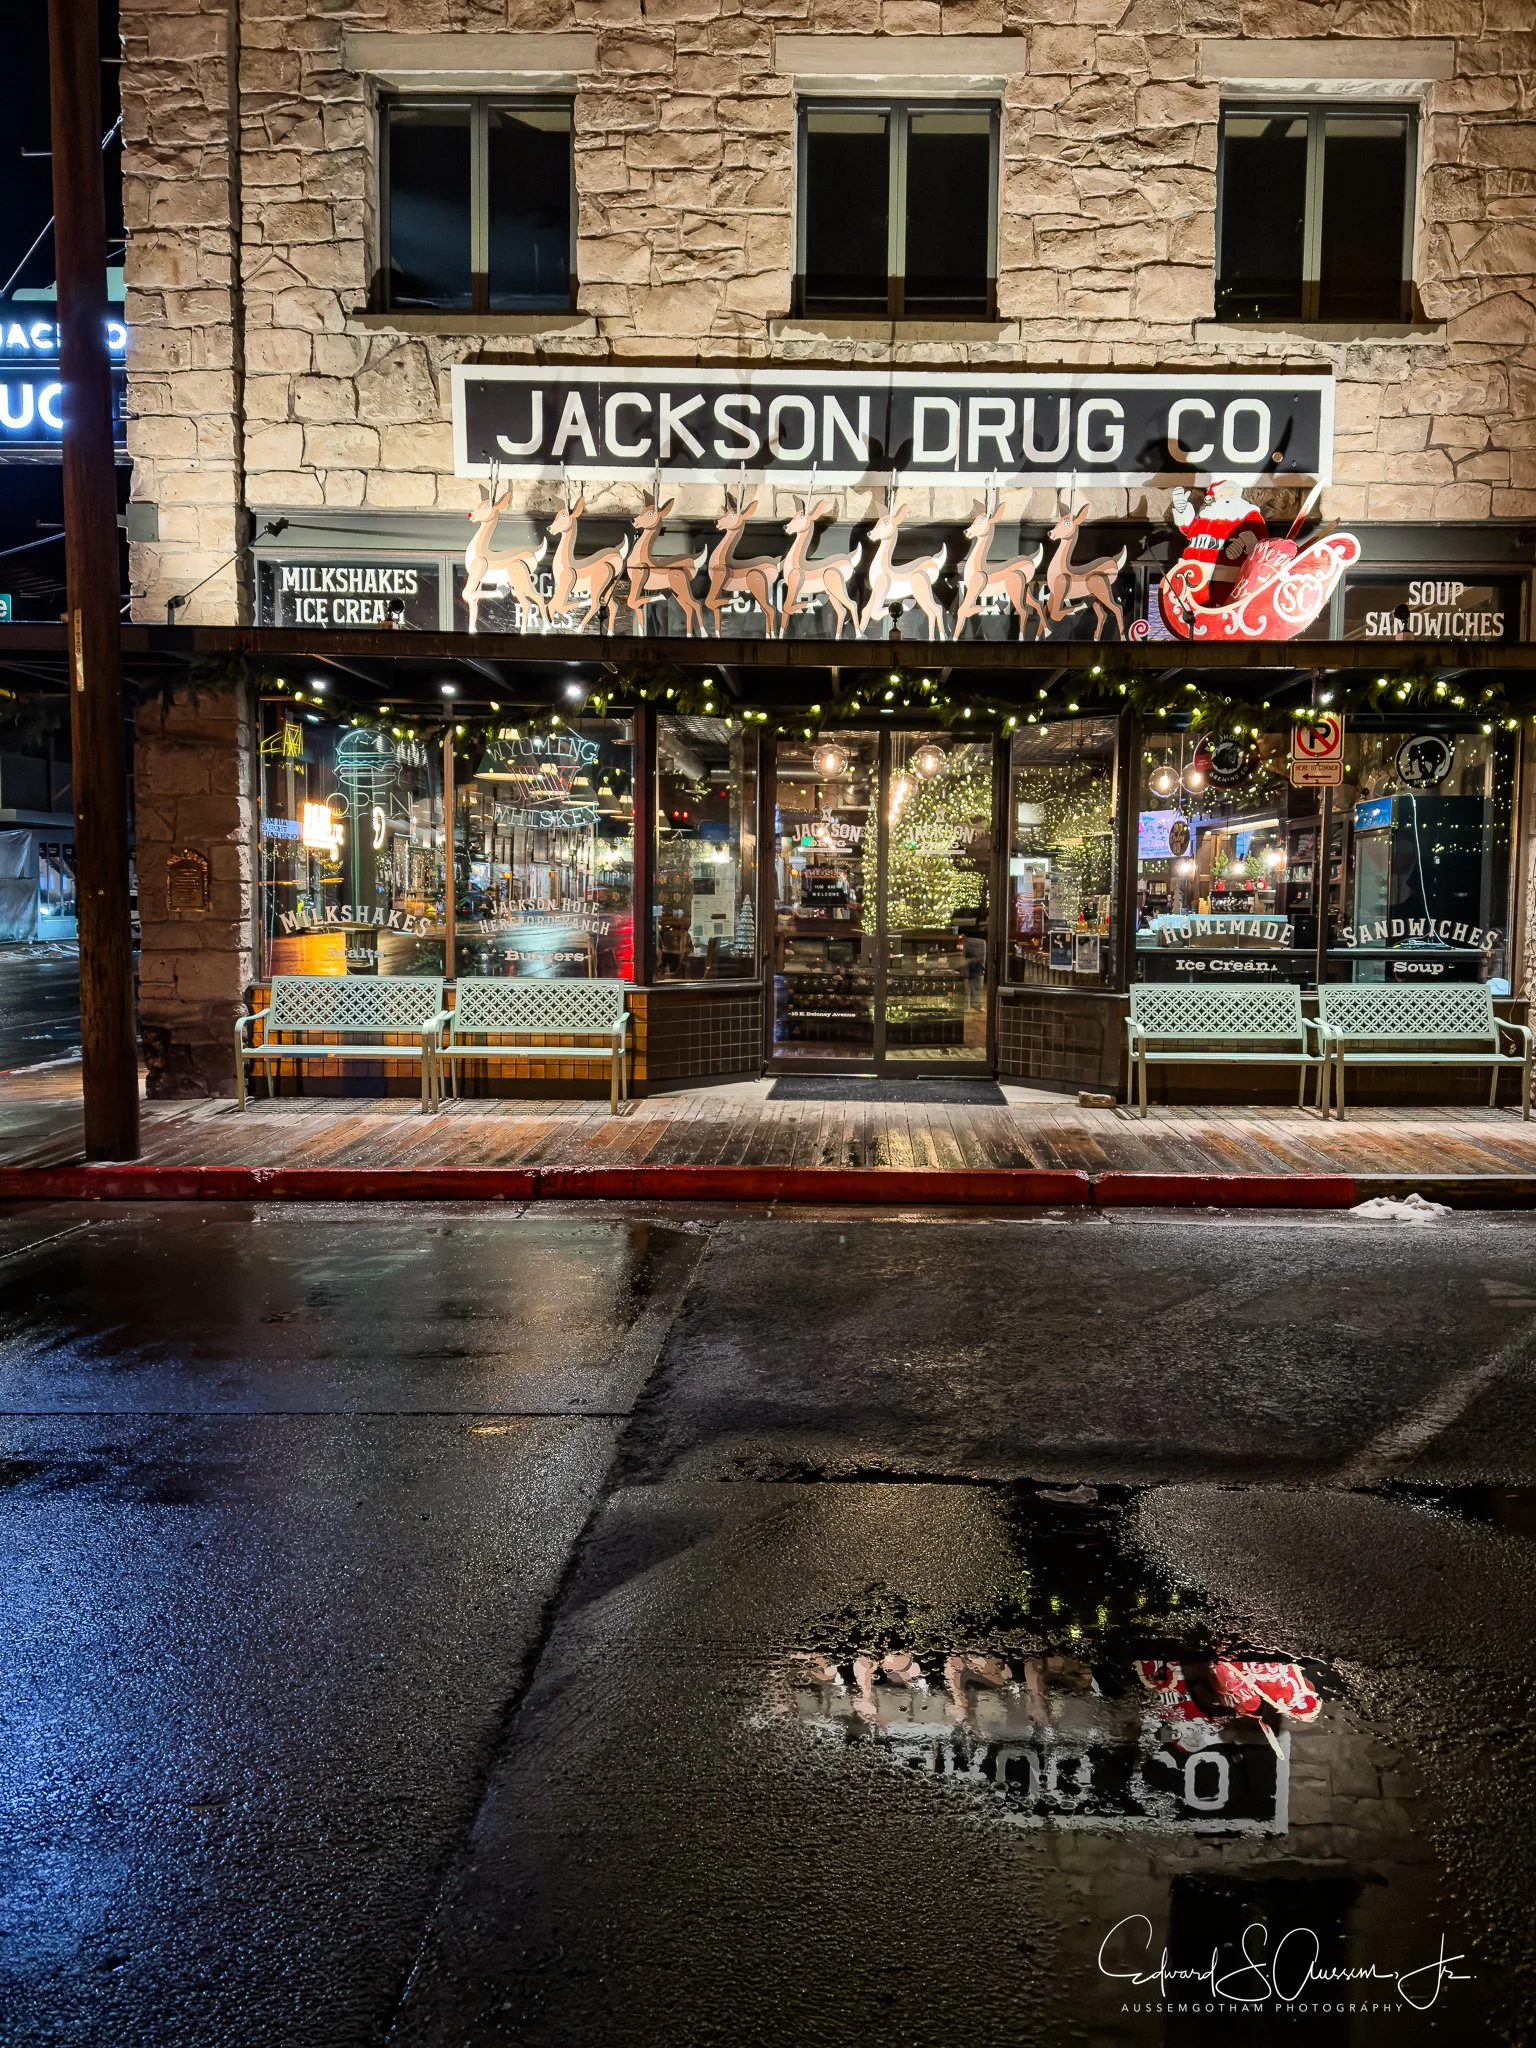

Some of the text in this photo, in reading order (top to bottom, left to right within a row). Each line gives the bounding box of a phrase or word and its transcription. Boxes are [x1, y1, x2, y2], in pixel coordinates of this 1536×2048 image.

[496, 390, 1284, 463] JACKSON DRUG CO.
[281, 567, 417, 594] MILKSHAKES
[1408, 581, 1464, 605] SOUP
[295, 598, 328, 623] ICE
[485, 735, 599, 761] WYOMING
[326, 792, 414, 819] OPEN
[494, 801, 601, 829] WHISKEY
[792, 823, 862, 842] JACKSON
[909, 824, 976, 844] JACKSON
[491, 898, 600, 916] JACKSON HOLE
[279, 905, 432, 937] MILKSHAKES
[561, 915, 610, 936] RANCH
[1162, 919, 1295, 945] HOMEMADE
[1342, 918, 1499, 951] SANDWICHES
[328, 948, 384, 959] Malts
[1176, 960, 1206, 971] Ice
[1393, 961, 1444, 975] Soup
